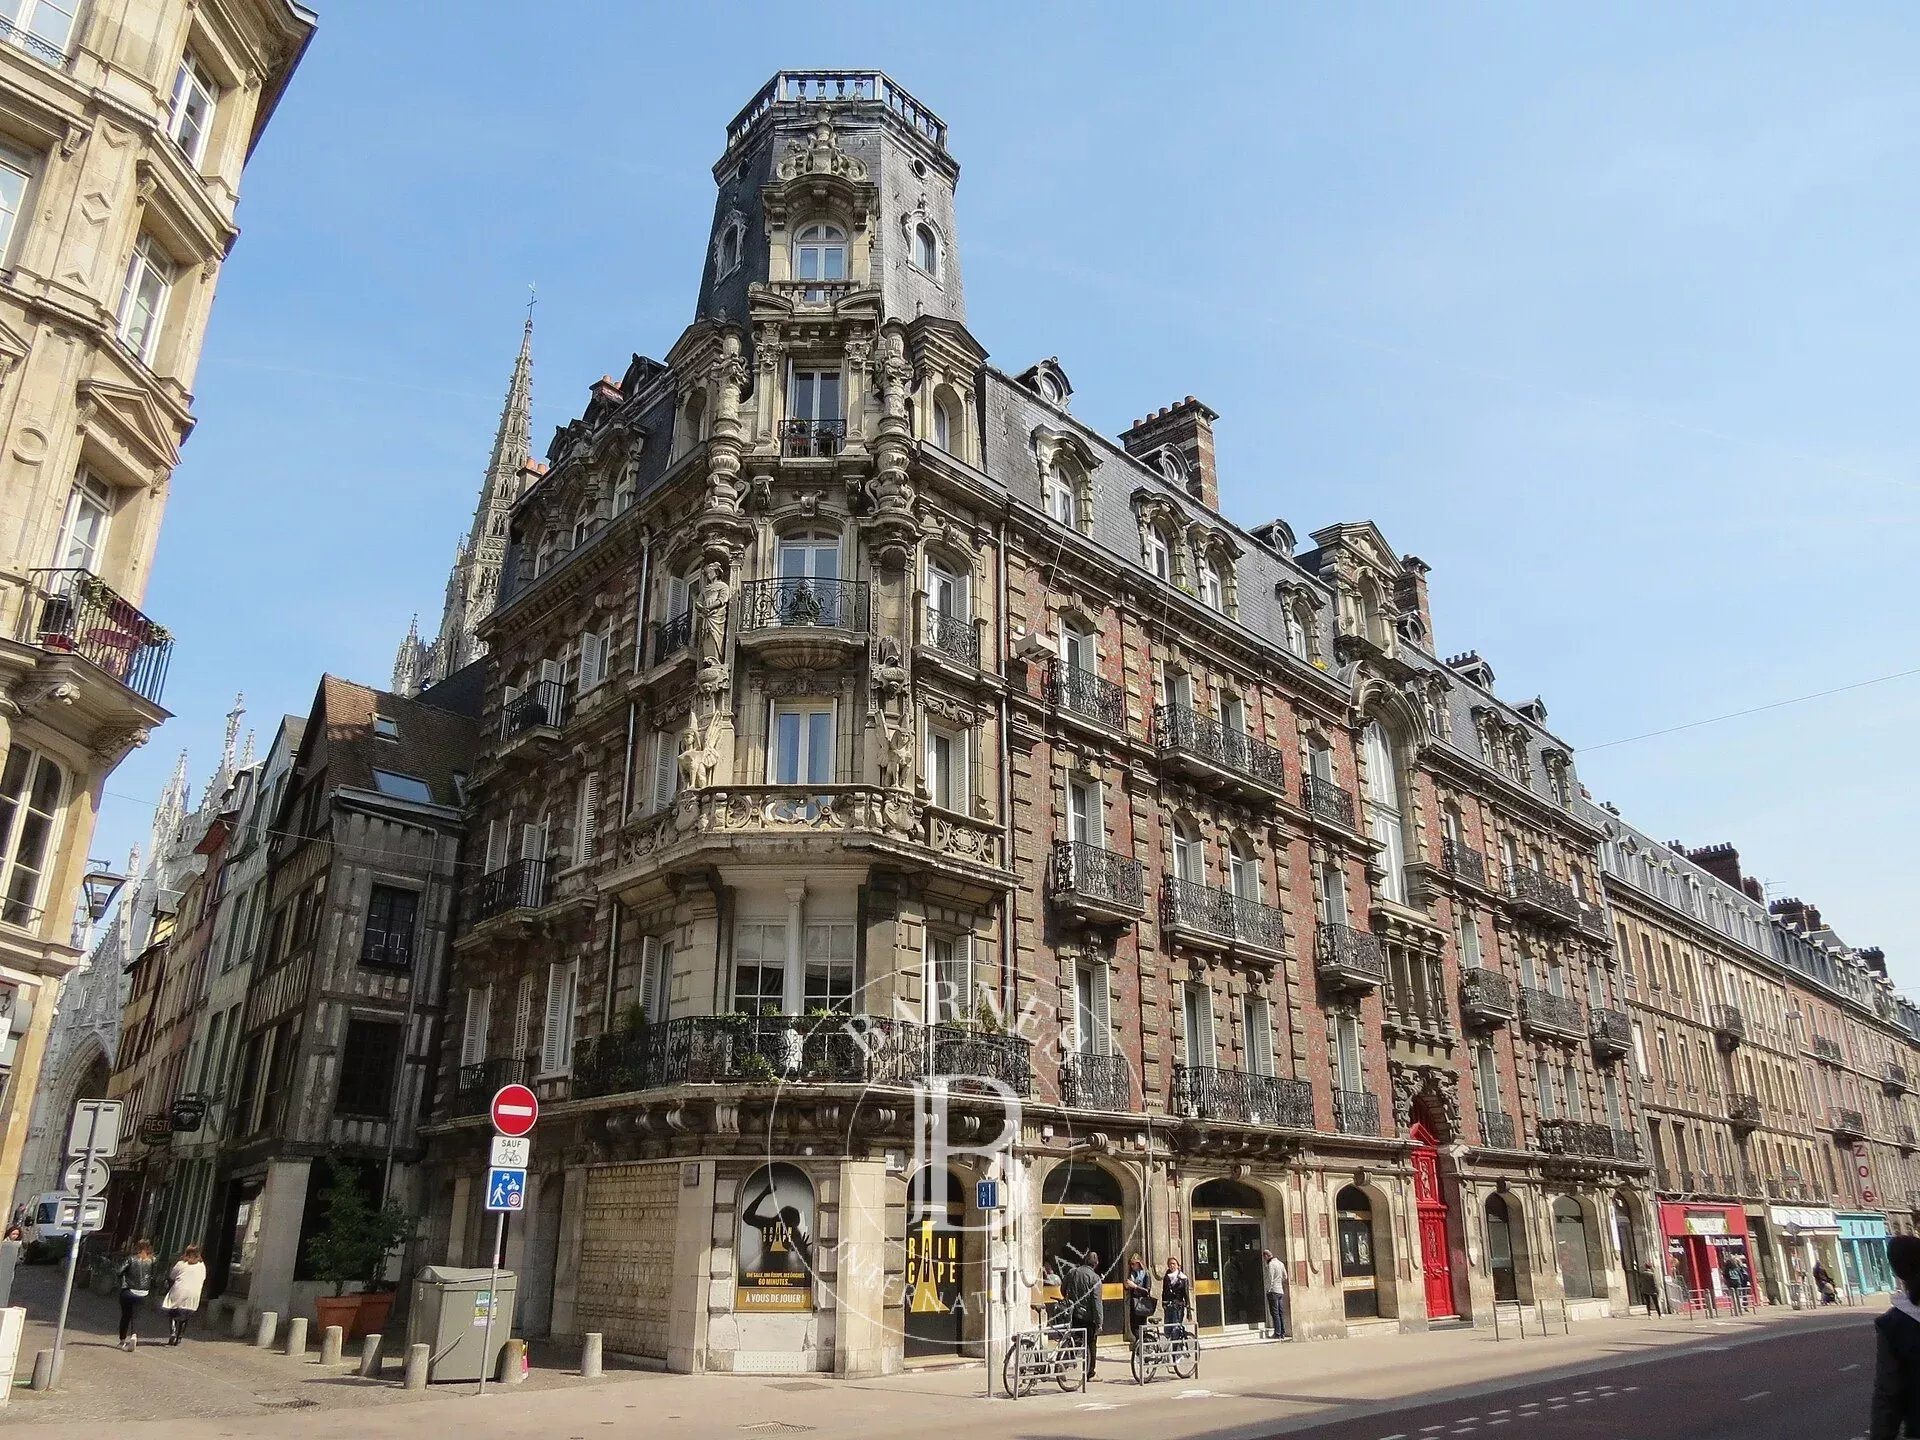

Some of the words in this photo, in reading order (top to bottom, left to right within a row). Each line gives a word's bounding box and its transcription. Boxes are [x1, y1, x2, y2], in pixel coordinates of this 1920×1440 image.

[501, 1139, 522, 1148] SAUF
[758, 1278, 766, 1286] 60
[751, 1294, 770, 1303] VOUS
[770, 1294, 779, 1303] DE
[779, 1294, 801, 1303] JOUER
